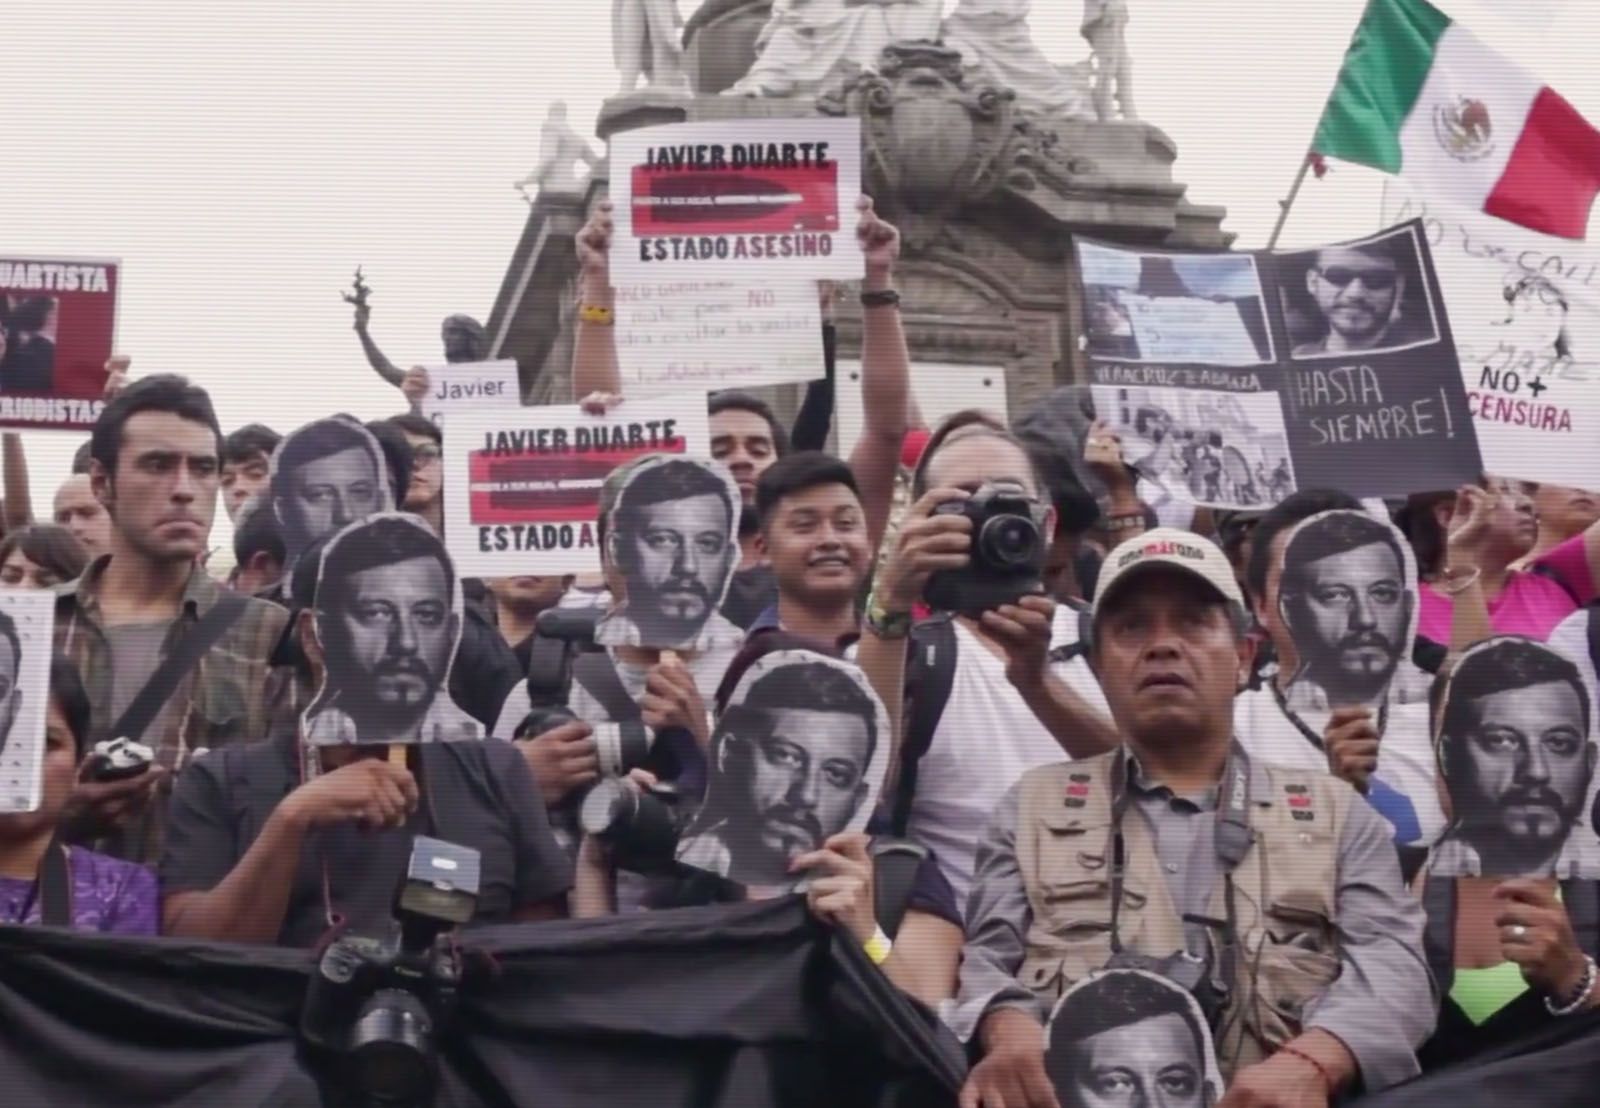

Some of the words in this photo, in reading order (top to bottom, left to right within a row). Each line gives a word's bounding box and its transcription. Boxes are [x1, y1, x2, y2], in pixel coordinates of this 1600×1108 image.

[647, 143, 727, 171] JAVIER
[731, 141, 830, 170] DUARTE
[639, 237, 729, 262] ESTADO
[733, 233, 833, 259] ASESINO
[436, 376, 506, 402] Javier
[1296, 364, 1384, 408] HASTA
[1478, 365, 1521, 394] NO
[0, 396, 107, 425] RIODISTAS
[1466, 391, 1573, 433] CENSURA
[483, 426, 569, 458] JAVIER
[575, 418, 678, 454] DUARTE
[478, 524, 574, 552] ESTADO
